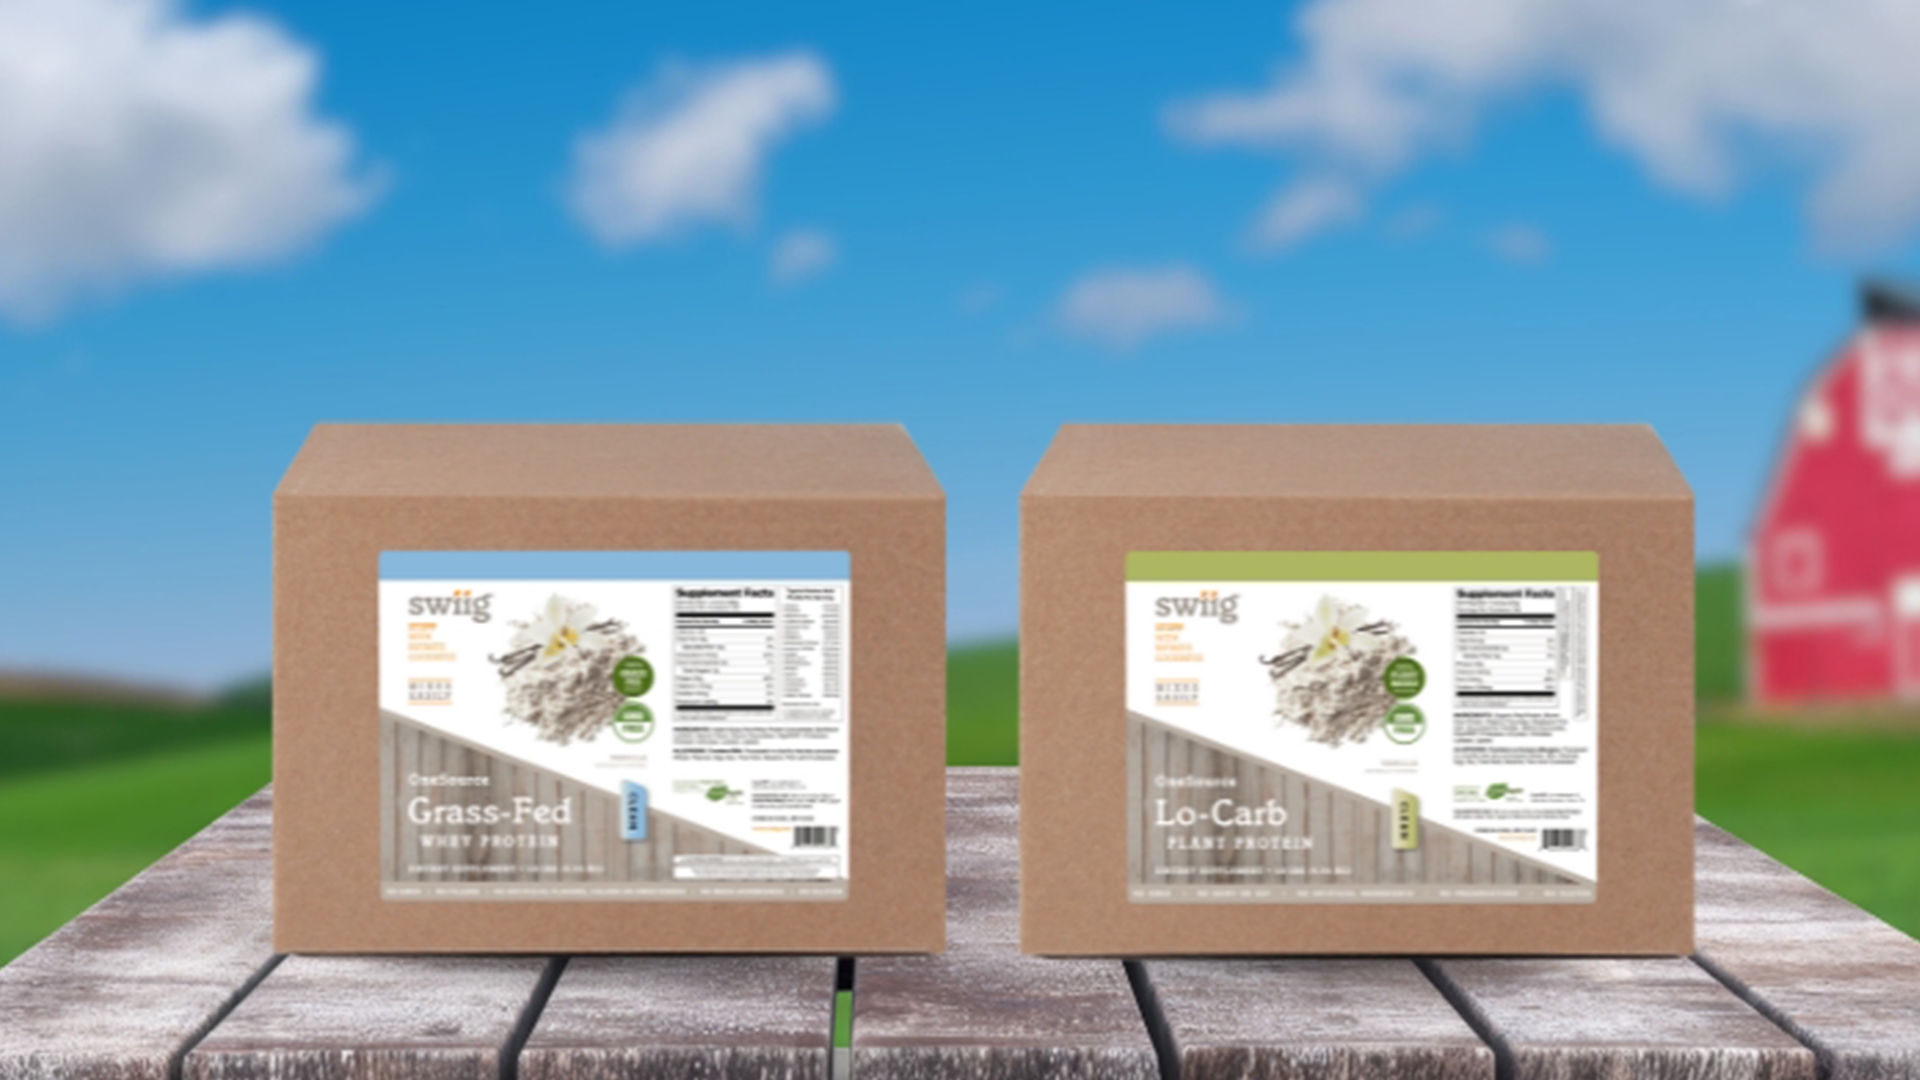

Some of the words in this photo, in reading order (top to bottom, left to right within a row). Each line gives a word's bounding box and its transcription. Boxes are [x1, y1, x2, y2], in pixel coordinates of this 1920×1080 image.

[675, 587, 742, 599] Supplement
[744, 587, 774, 599] Facts
[1456, 588, 1523, 599] Supplement
[1524, 588, 1556, 599] Facts
[407, 589, 495, 624] swiig
[1154, 590, 1241, 625] swiig
[407, 772, 491, 787] OneSource
[1154, 774, 1237, 788] OneSource
[407, 796, 573, 826] Grass-Fed
[1154, 798, 1288, 827] Lo-Carb
[419, 833, 473, 849] WHEY
[479, 833, 560, 849] PROTEIN
[1167, 836, 1226, 850] PLANT
[1234, 836, 1315, 850] PROTEIN
